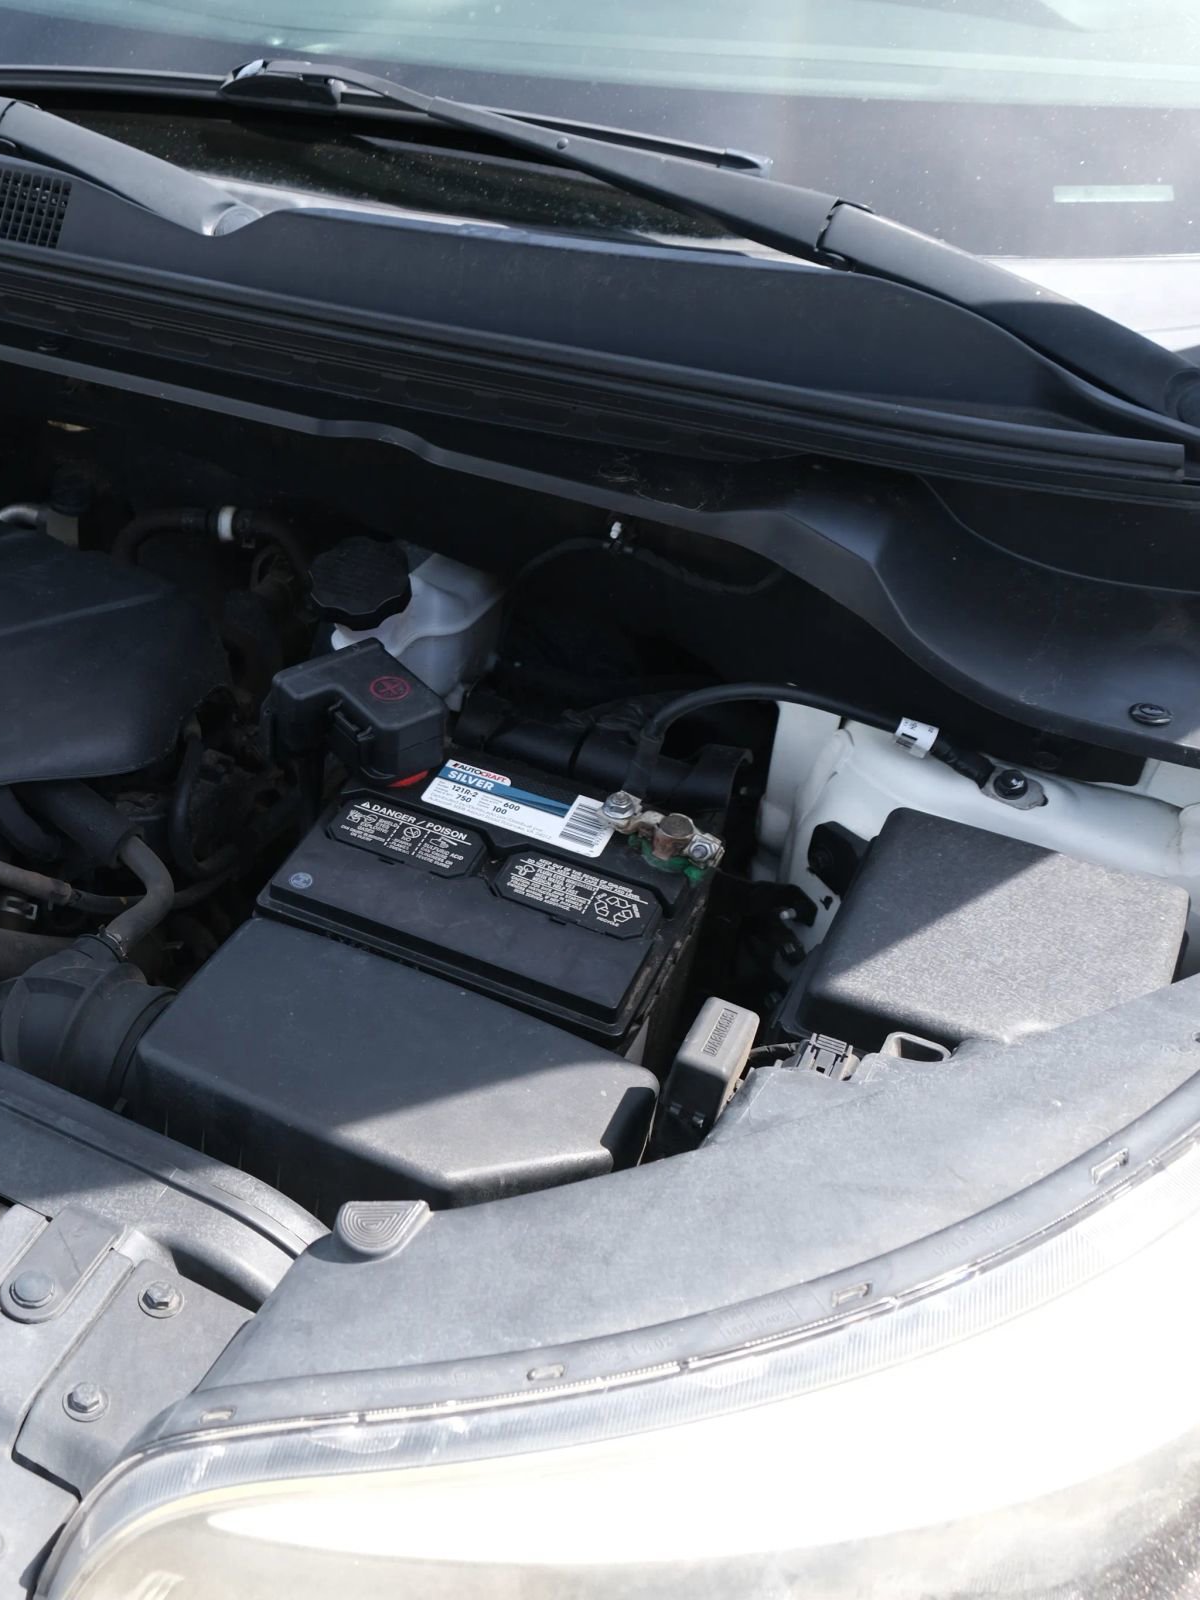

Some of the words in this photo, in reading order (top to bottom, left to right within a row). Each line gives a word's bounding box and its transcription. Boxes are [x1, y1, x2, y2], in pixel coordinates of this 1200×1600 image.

[448, 770, 494, 790] SILVER
[457, 764, 507, 782] AUTOCRAFT
[452, 785, 478, 797] 121R-2
[503, 802, 520, 812] 600
[456, 794, 471, 803] 750
[492, 805, 507, 815] 100
[371, 804, 417, 824] DANGER
[426, 822, 468, 841] POISON
